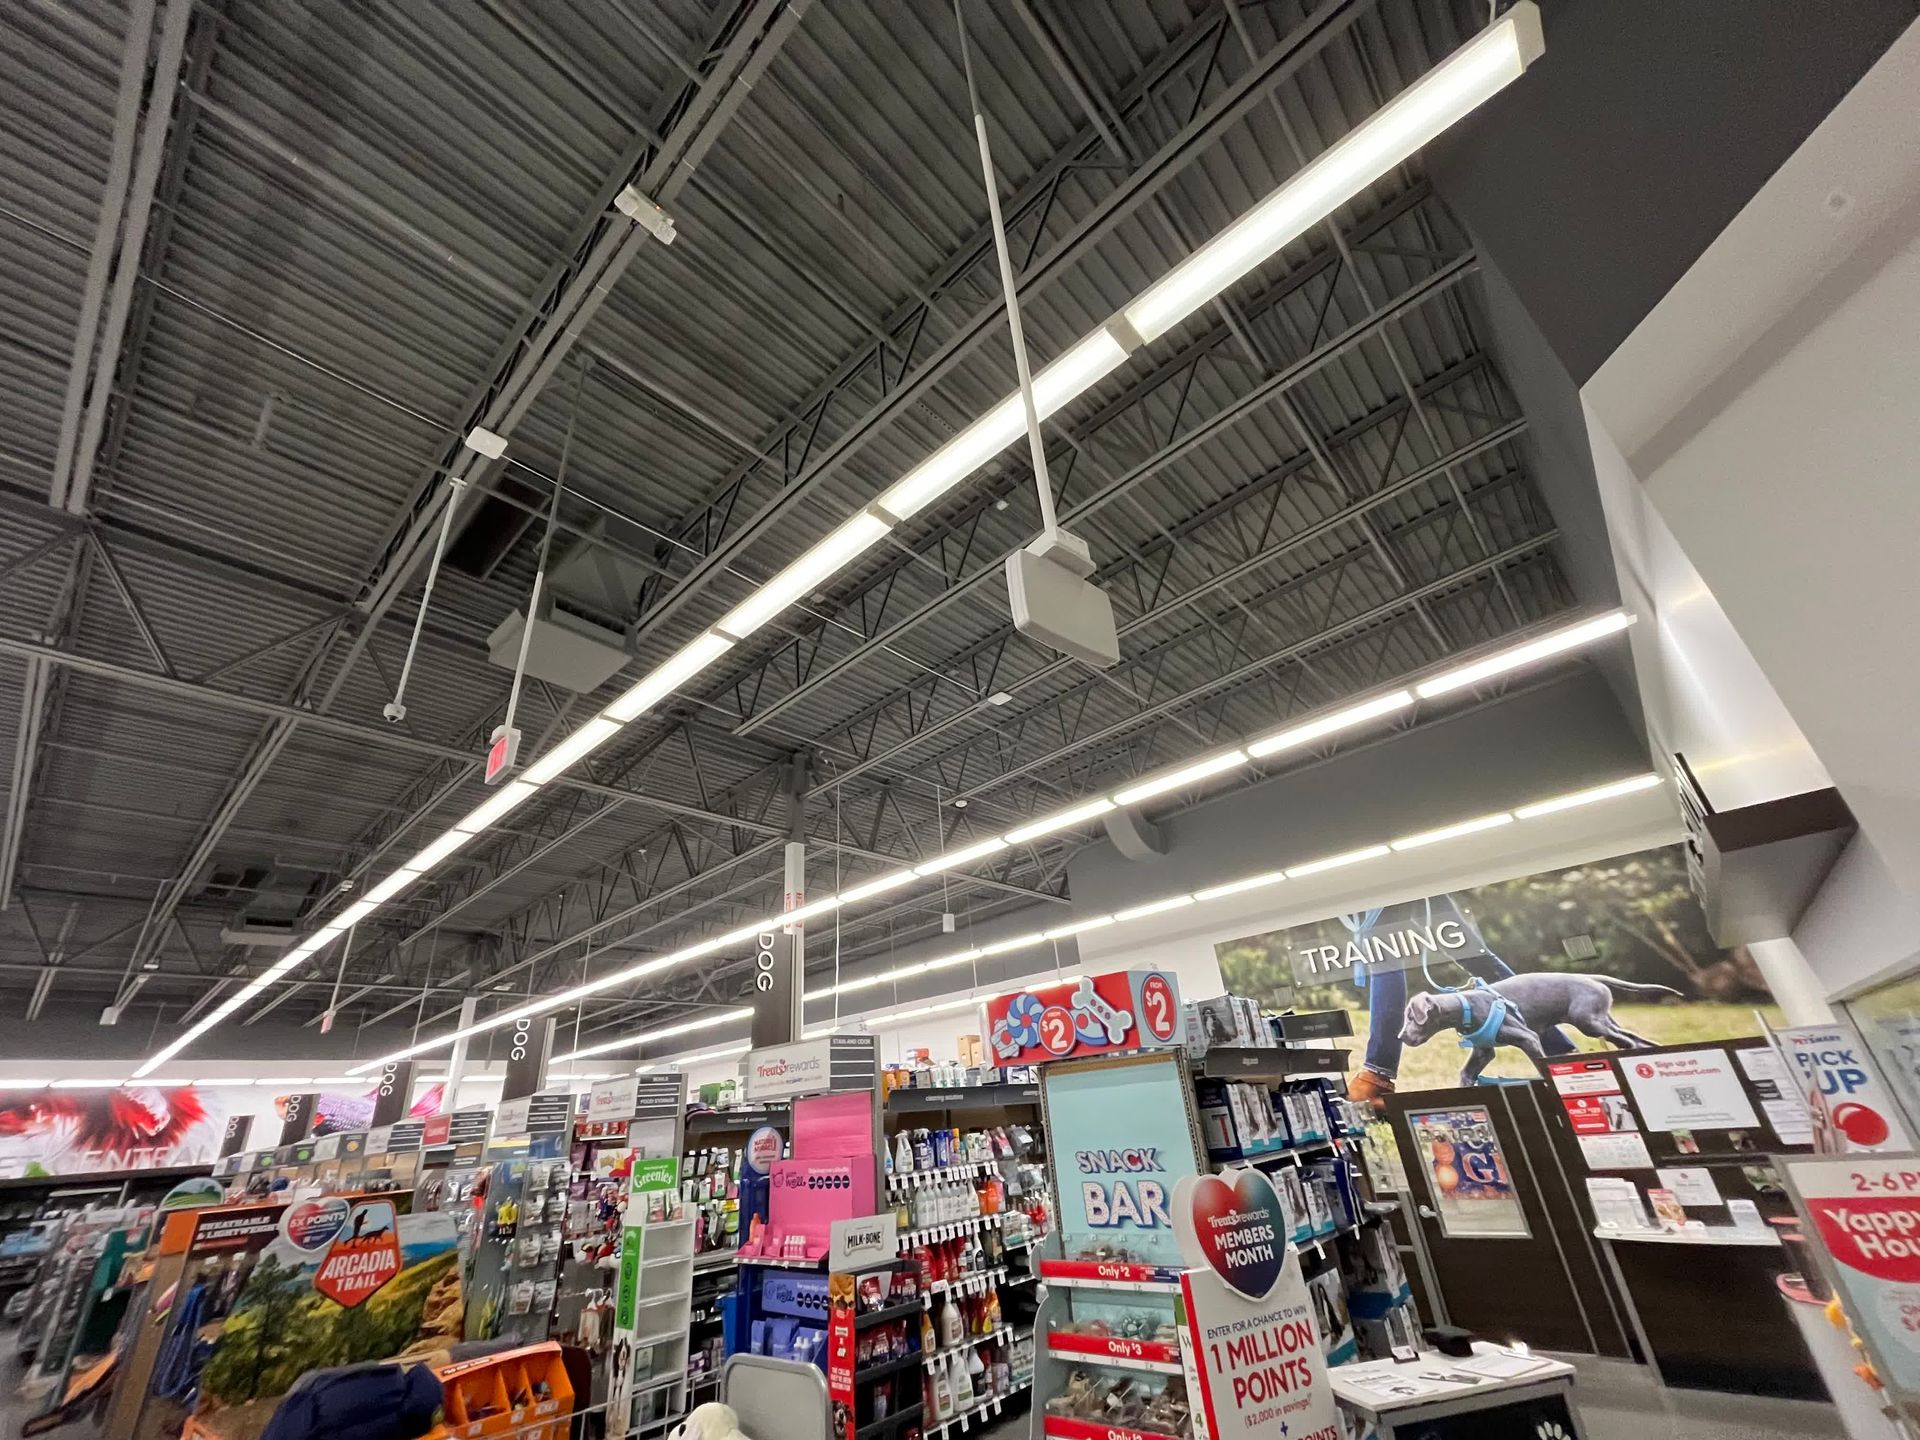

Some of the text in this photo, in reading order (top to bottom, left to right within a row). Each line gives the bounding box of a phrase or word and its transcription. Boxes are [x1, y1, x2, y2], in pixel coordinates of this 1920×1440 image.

[1299, 920, 1467, 974] TRAINING
[757, 932, 775, 993] DOG
[1149, 980, 1163, 988] FROM
[1145, 991, 1171, 1032] $2
[510, 1018, 531, 1061] DOG
[1041, 1018, 1068, 1049] $2
[1794, 1049, 1859, 1068] PICK
[379, 1062, 399, 1098] DOG
[285, 1094, 302, 1123] DOG
[225, 1116, 241, 1139] DOG
[1075, 1148, 1165, 1174] SNACK
[633, 1168, 673, 1189] Greenies
[306, 1211, 346, 1226] POINTS
[1081, 1180, 1172, 1228] BAR
[1213, 1224, 1275, 1251] MEMBERS
[320, 1249, 396, 1281] ARCADIA
[1225, 1244, 1274, 1269] MONTH
[1097, 1265, 1120, 1279] Only
[1120, 1265, 1131, 1278] $2
[1207, 1304, 1307, 1340] ENTER FOR A CHANCE TO WIN
[1108, 1341, 1143, 1357] Only $3
[1210, 1318, 1315, 1374] 1 MILLION
[1233, 1356, 1313, 1409] POINTS
